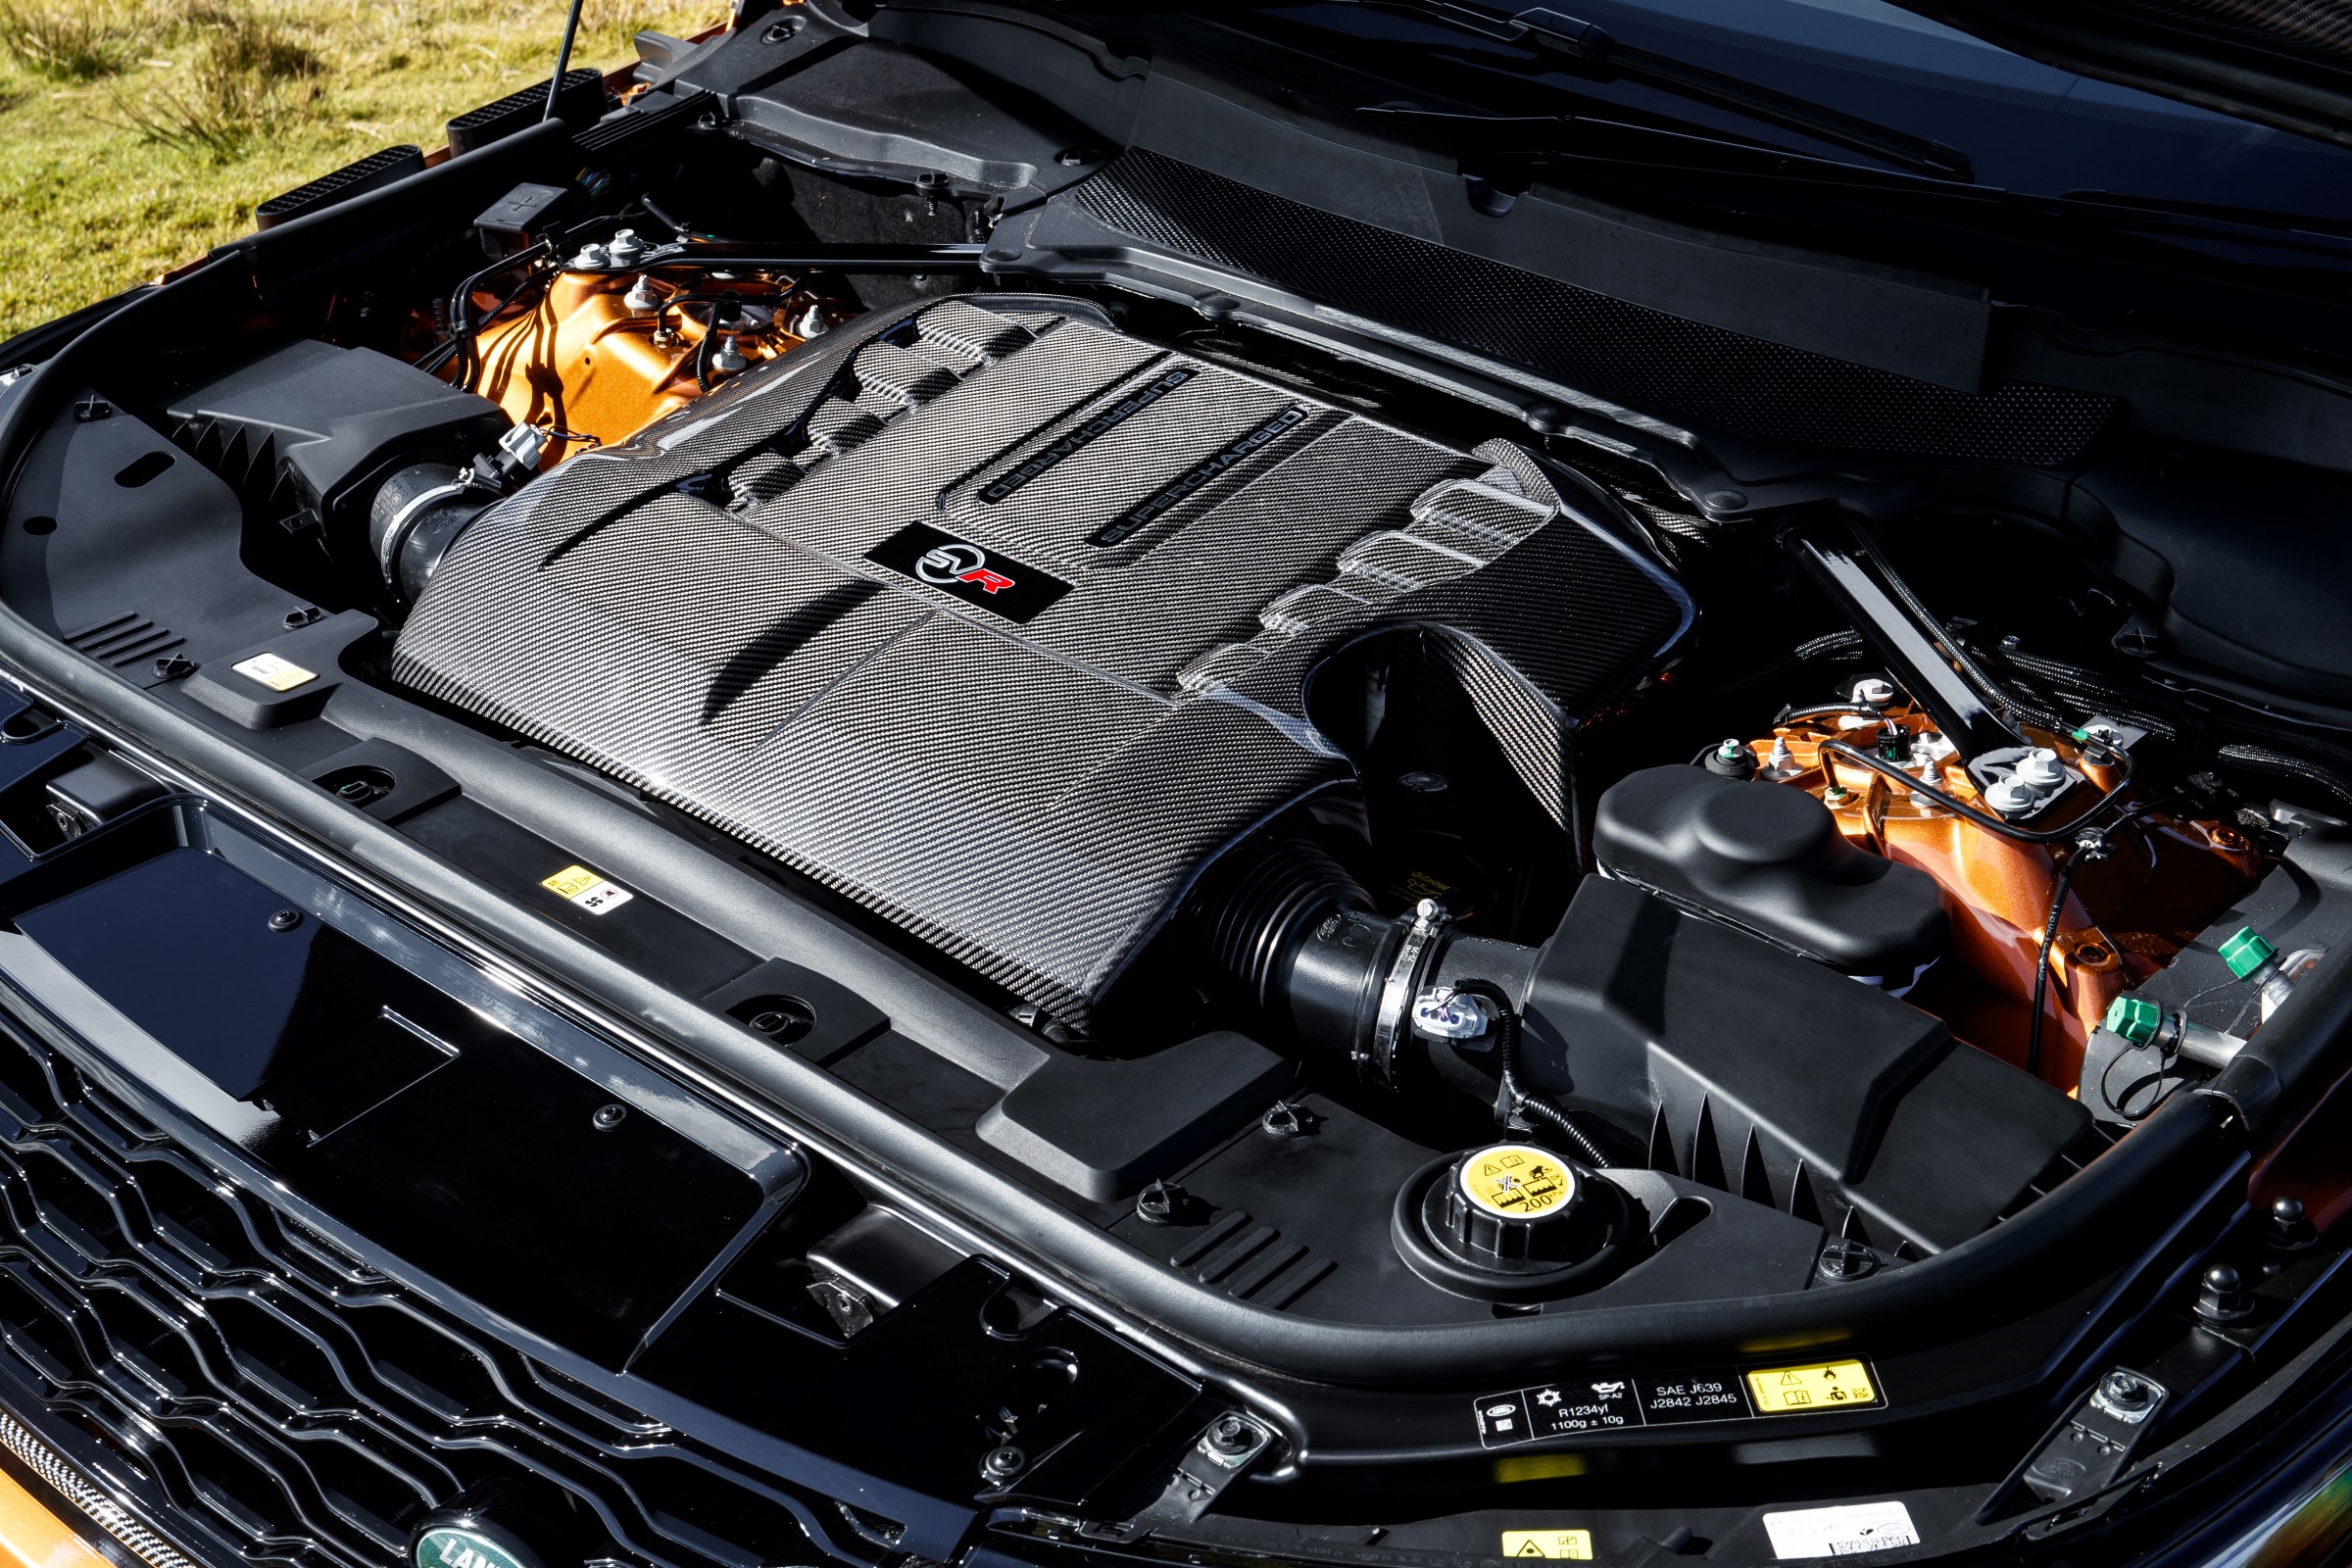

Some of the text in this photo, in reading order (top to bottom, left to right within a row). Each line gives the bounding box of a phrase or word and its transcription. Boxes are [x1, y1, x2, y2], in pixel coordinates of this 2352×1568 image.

[988, 371, 1189, 498] SUPERCHARGED
[1101, 410, 1303, 543] SUPERCHARGED
[916, 544, 1015, 596] SVR
[1519, 1195, 1552, 1212] 200
[1656, 1383, 1723, 1396] SAE J639
[1650, 1394, 1738, 1409] J2842 J2845
[1558, 1403, 1609, 1418] R1234yf
[1551, 1419, 1587, 1431] 1100g
[1602, 1415, 1624, 1425] 10g
